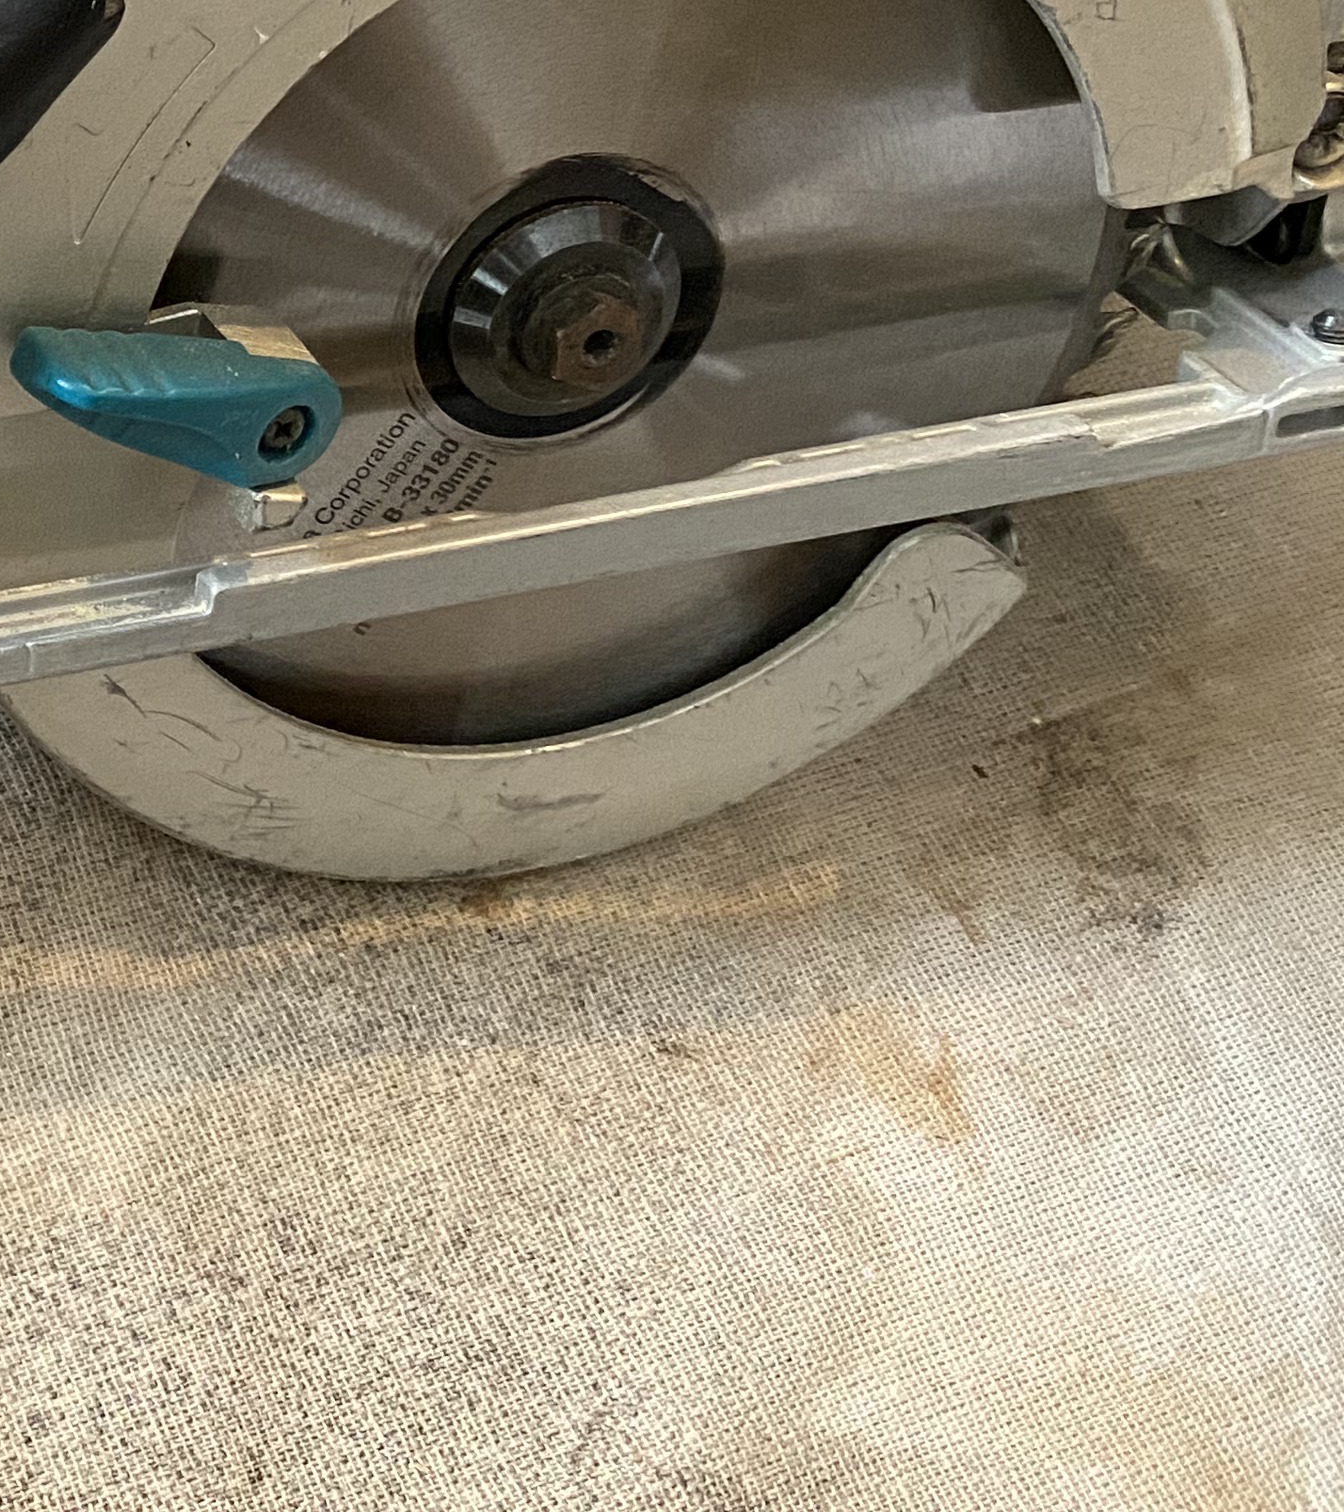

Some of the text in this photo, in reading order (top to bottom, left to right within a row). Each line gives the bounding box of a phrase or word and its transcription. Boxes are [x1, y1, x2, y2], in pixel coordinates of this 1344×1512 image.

[315, 412, 416, 524] Corporation
[334, 439, 426, 532] ichi, Japan
[382, 438, 460, 523] B-33180
